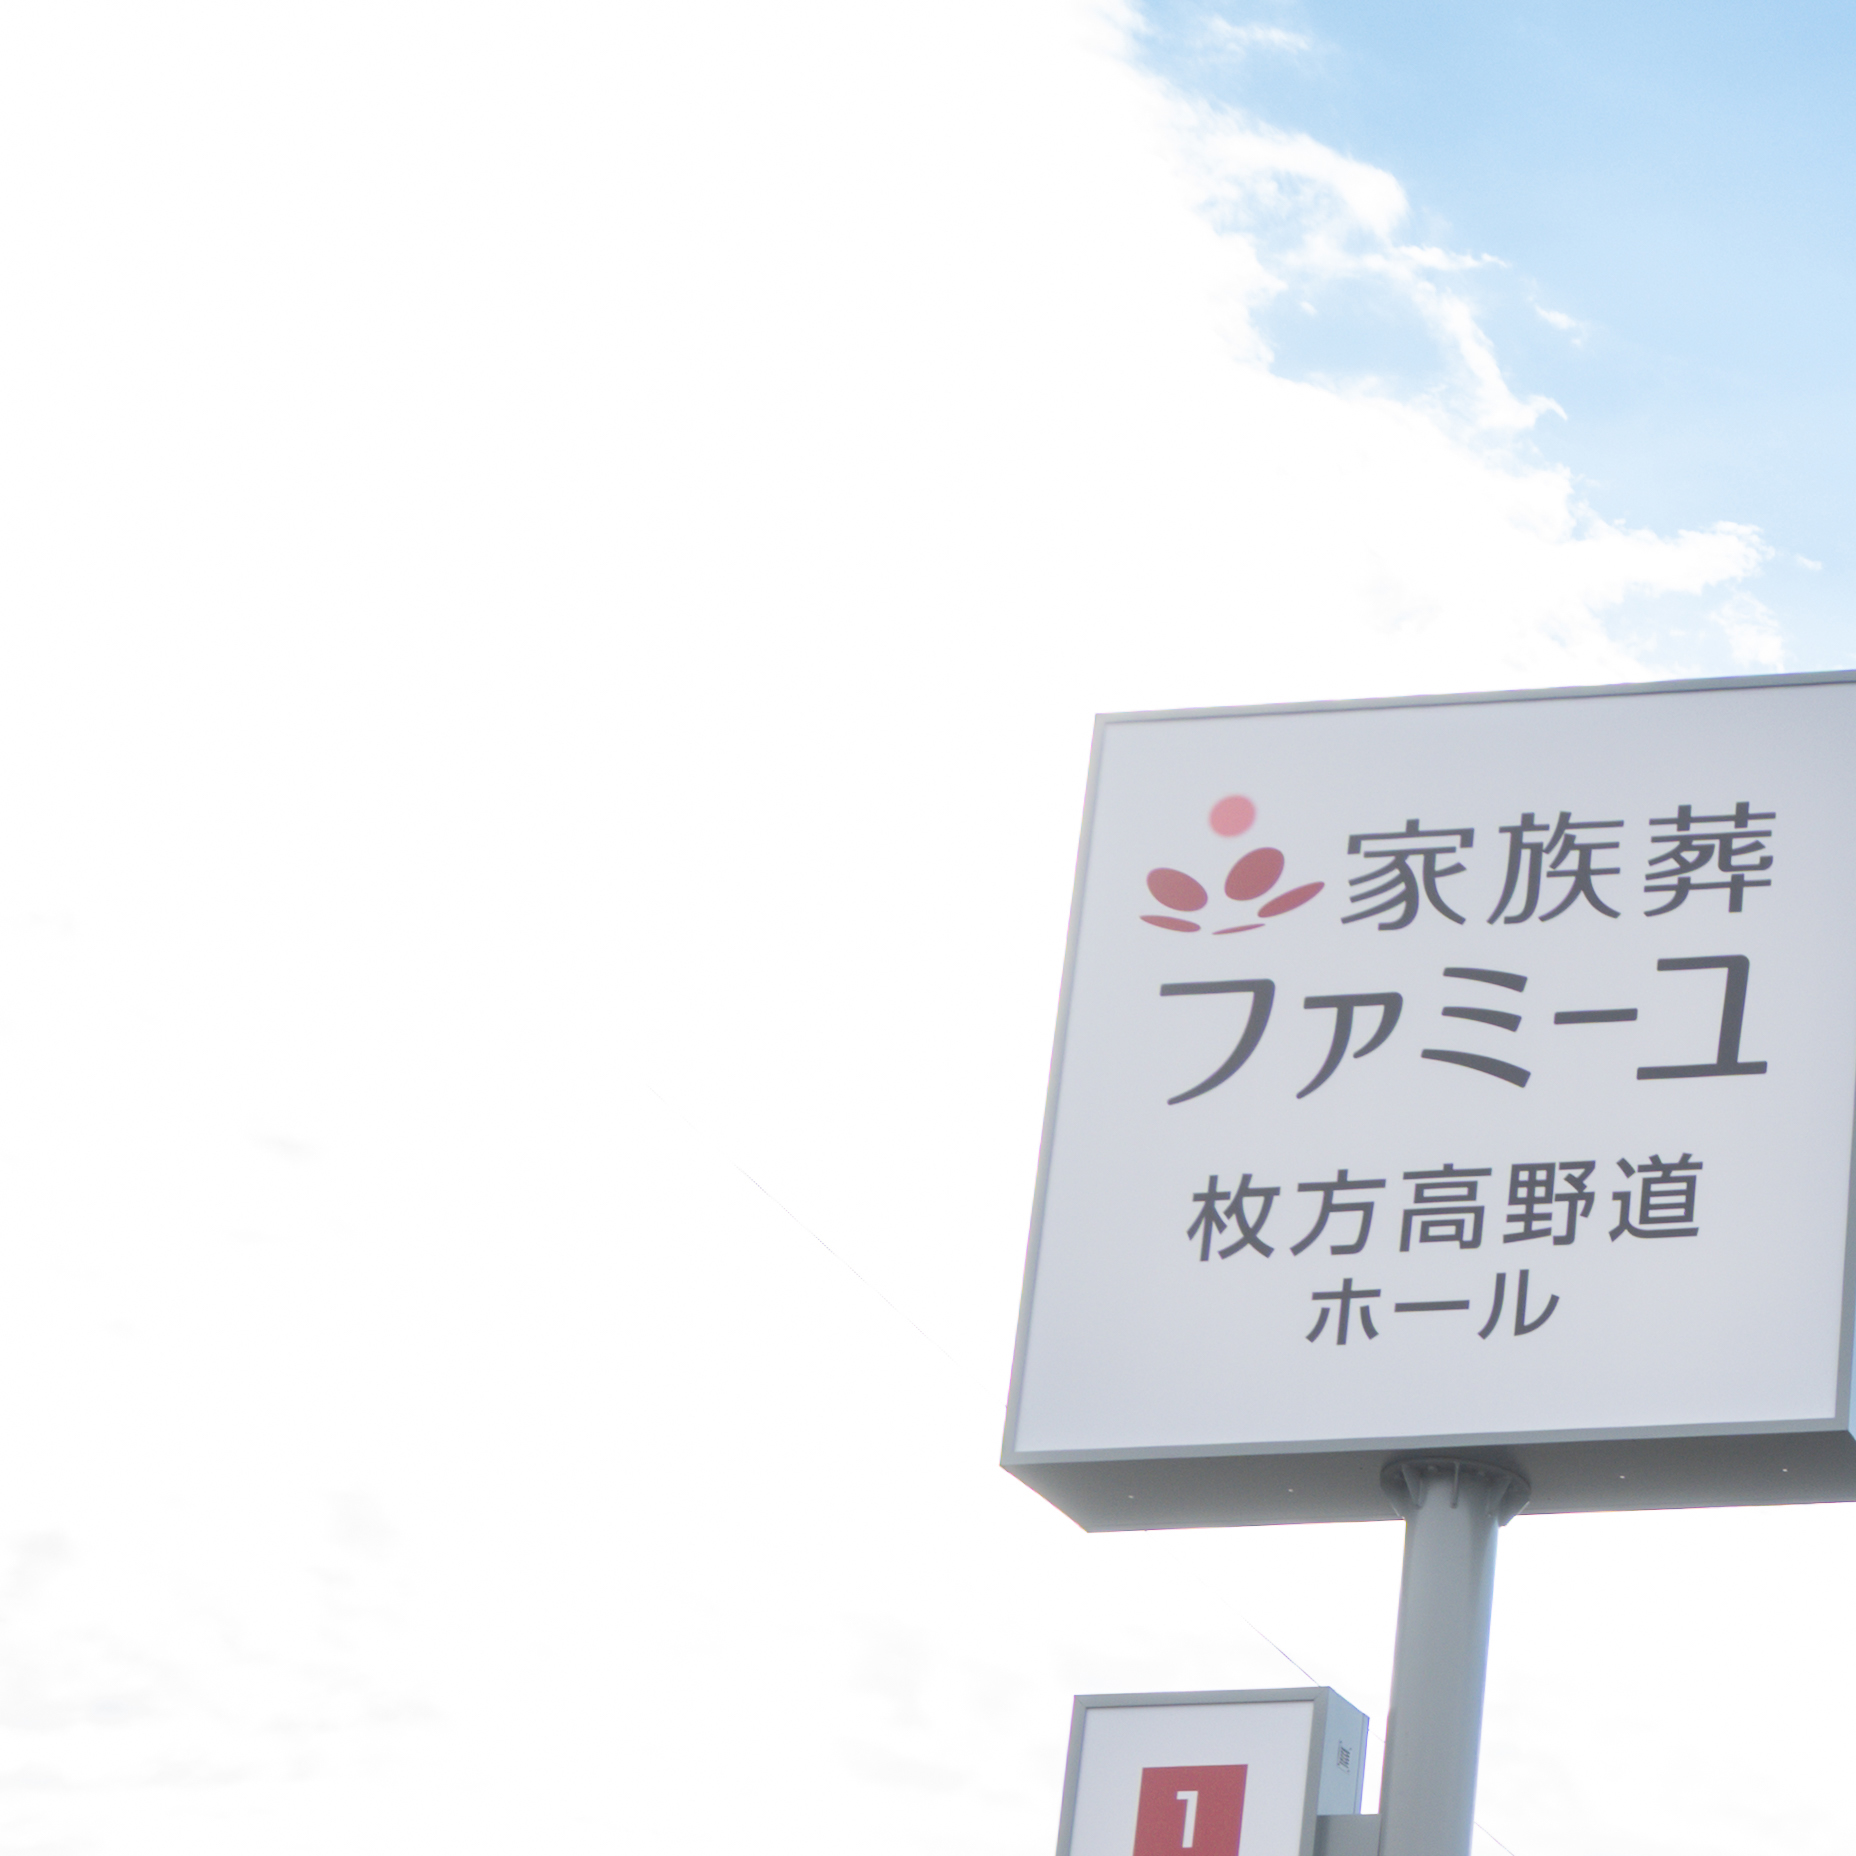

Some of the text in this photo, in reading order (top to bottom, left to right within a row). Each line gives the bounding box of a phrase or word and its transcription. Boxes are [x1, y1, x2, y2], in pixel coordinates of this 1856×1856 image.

[1340, 801, 1777, 931] 家族葬
[1159, 954, 1768, 1106] ファミーユ
[1186, 1152, 1704, 1262] 枚方高野道
[1305, 1268, 1560, 1346] ホール
